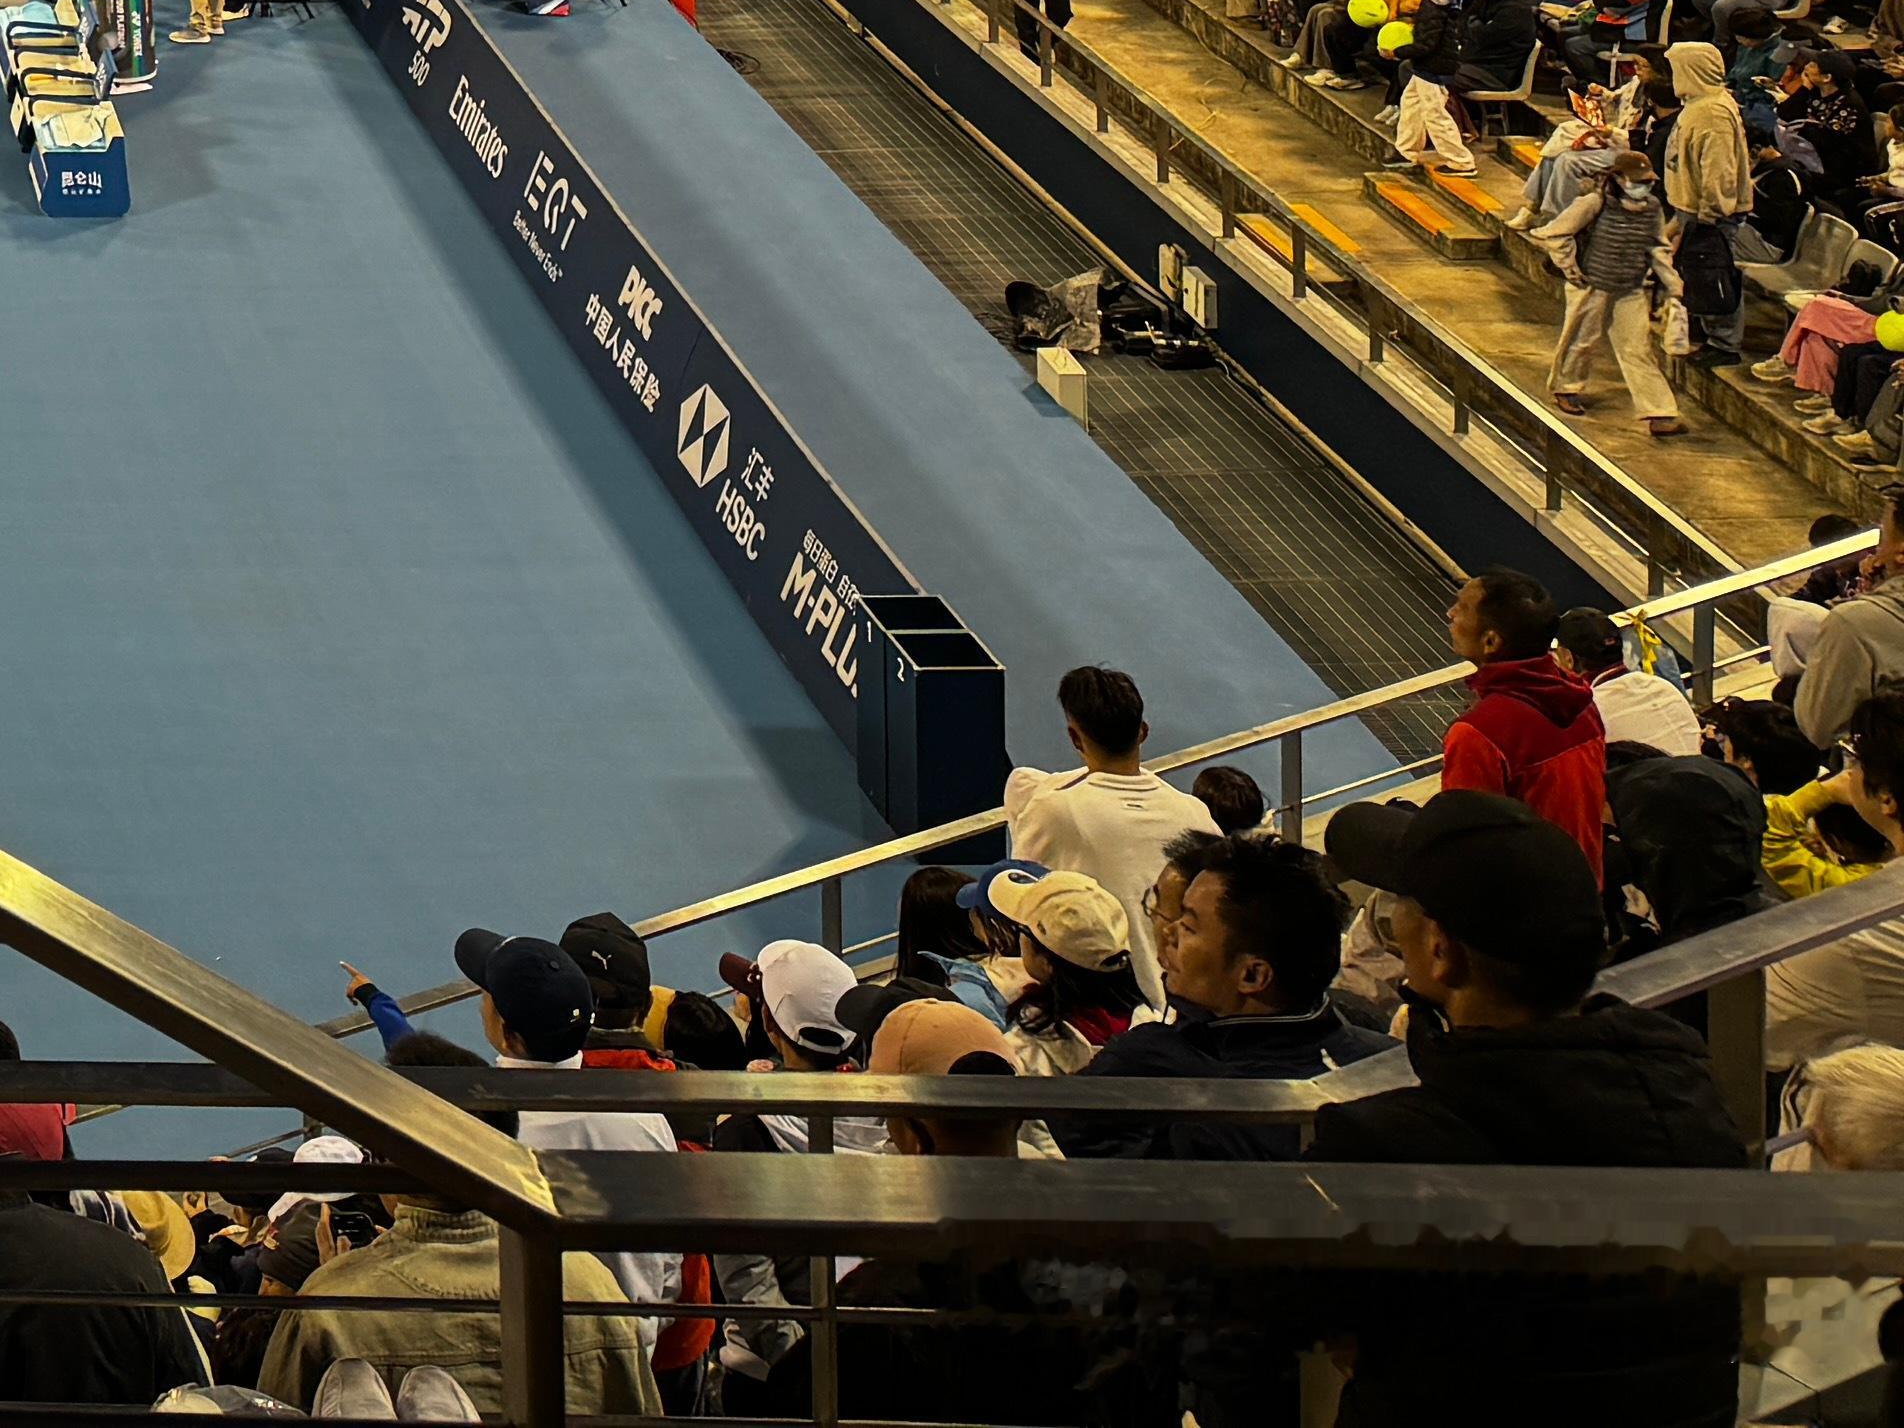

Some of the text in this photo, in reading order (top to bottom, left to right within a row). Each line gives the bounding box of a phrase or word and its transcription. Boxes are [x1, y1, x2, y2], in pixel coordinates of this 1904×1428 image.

[408, 49, 430, 87] 500
[448, 74, 509, 179] Emirates
[61, 170, 102, 188] 昆仑山
[524, 149, 588, 252] EQT
[618, 264, 663, 342] PICC
[585, 293, 661, 413] 中国人民保险
[741, 447, 775, 502] 汇丰
[715, 478, 766, 561] HSBC
